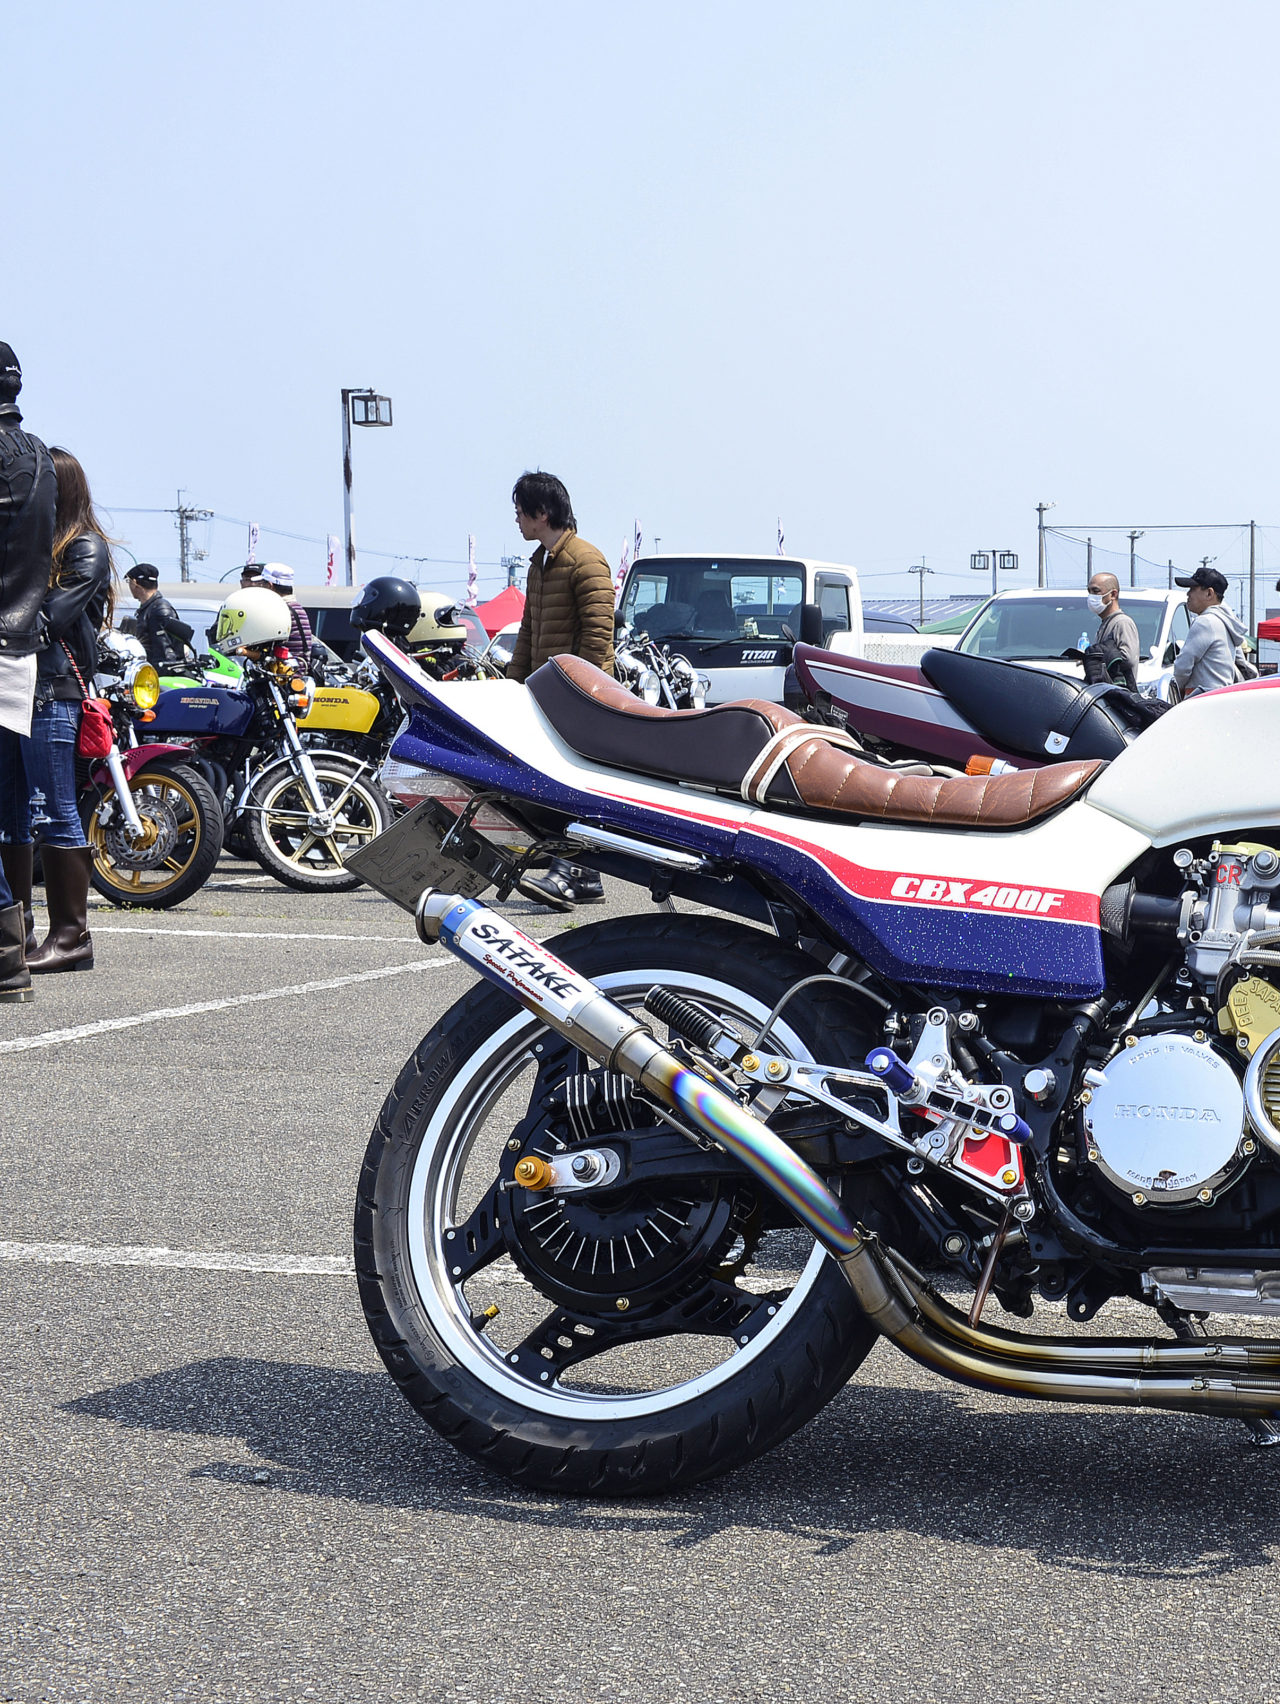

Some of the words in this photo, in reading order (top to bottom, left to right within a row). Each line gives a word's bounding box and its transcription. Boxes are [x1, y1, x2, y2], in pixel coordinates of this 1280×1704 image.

[741, 650, 778, 660] TITAN
[1216, 864, 1242, 885] CR
[890, 876, 1065, 913] CBX400F
[471, 924, 582, 999] SATAKE
[482, 953, 507, 975] Special
[506, 970, 544, 1002] Performance
[1233, 986, 1254, 1027] BEET
[1181, 1045, 1221, 1070] VALVES
[1114, 1104, 1222, 1123] HONDA
[1126, 1169, 1152, 1188] MADE
[1154, 1177, 1166, 1189] IN
[1167, 1172, 1198, 1189] JAPAN
